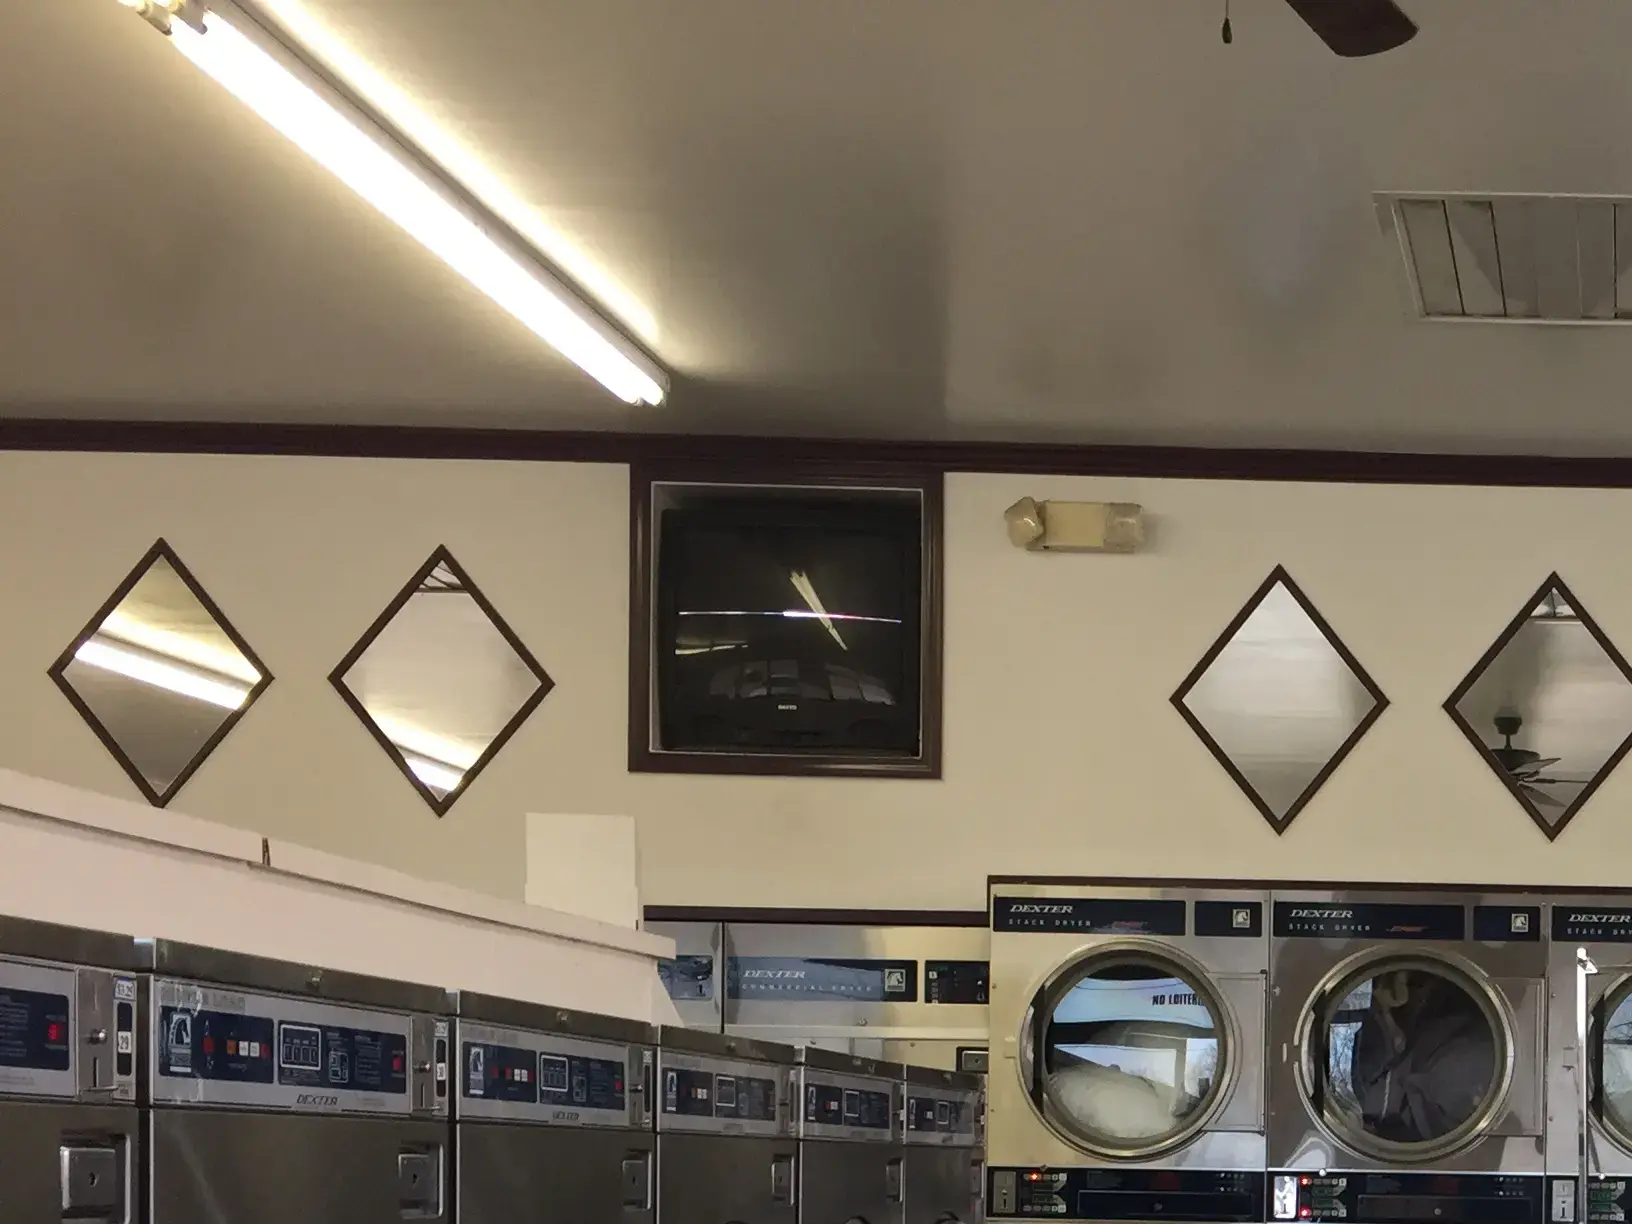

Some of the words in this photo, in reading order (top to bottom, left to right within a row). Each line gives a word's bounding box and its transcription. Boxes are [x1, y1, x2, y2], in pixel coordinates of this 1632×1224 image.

[1009, 904, 1074, 914] DEXTER
[1289, 909, 1354, 919] DEXTER
[1567, 913, 1632, 923] DEXTER
[742, 969, 806, 980] DEXTER
[1151, 994, 1166, 1006] NO
[295, 1094, 338, 1106] DEXTER
